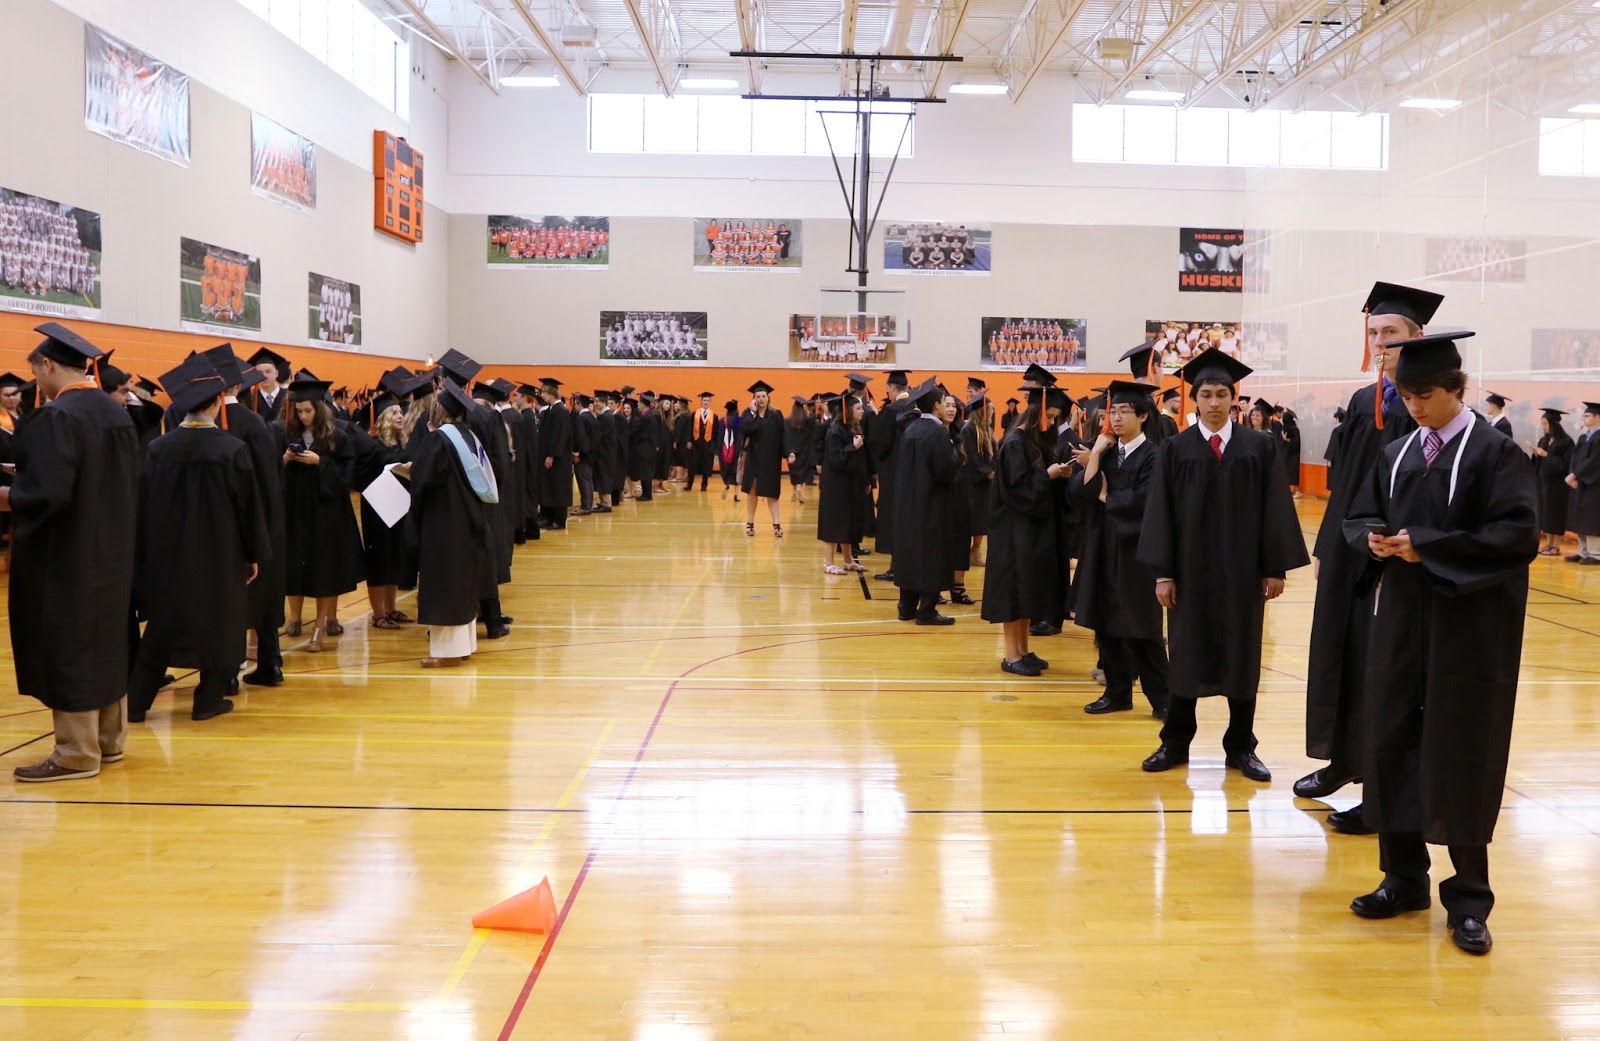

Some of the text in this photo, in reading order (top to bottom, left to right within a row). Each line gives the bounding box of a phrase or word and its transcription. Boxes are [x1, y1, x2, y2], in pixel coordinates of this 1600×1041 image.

[1194, 233, 1221, 241] HOME
[1223, 233, 1236, 241] OF
[7, 299, 67, 314] VARSITY FOOTBALL
